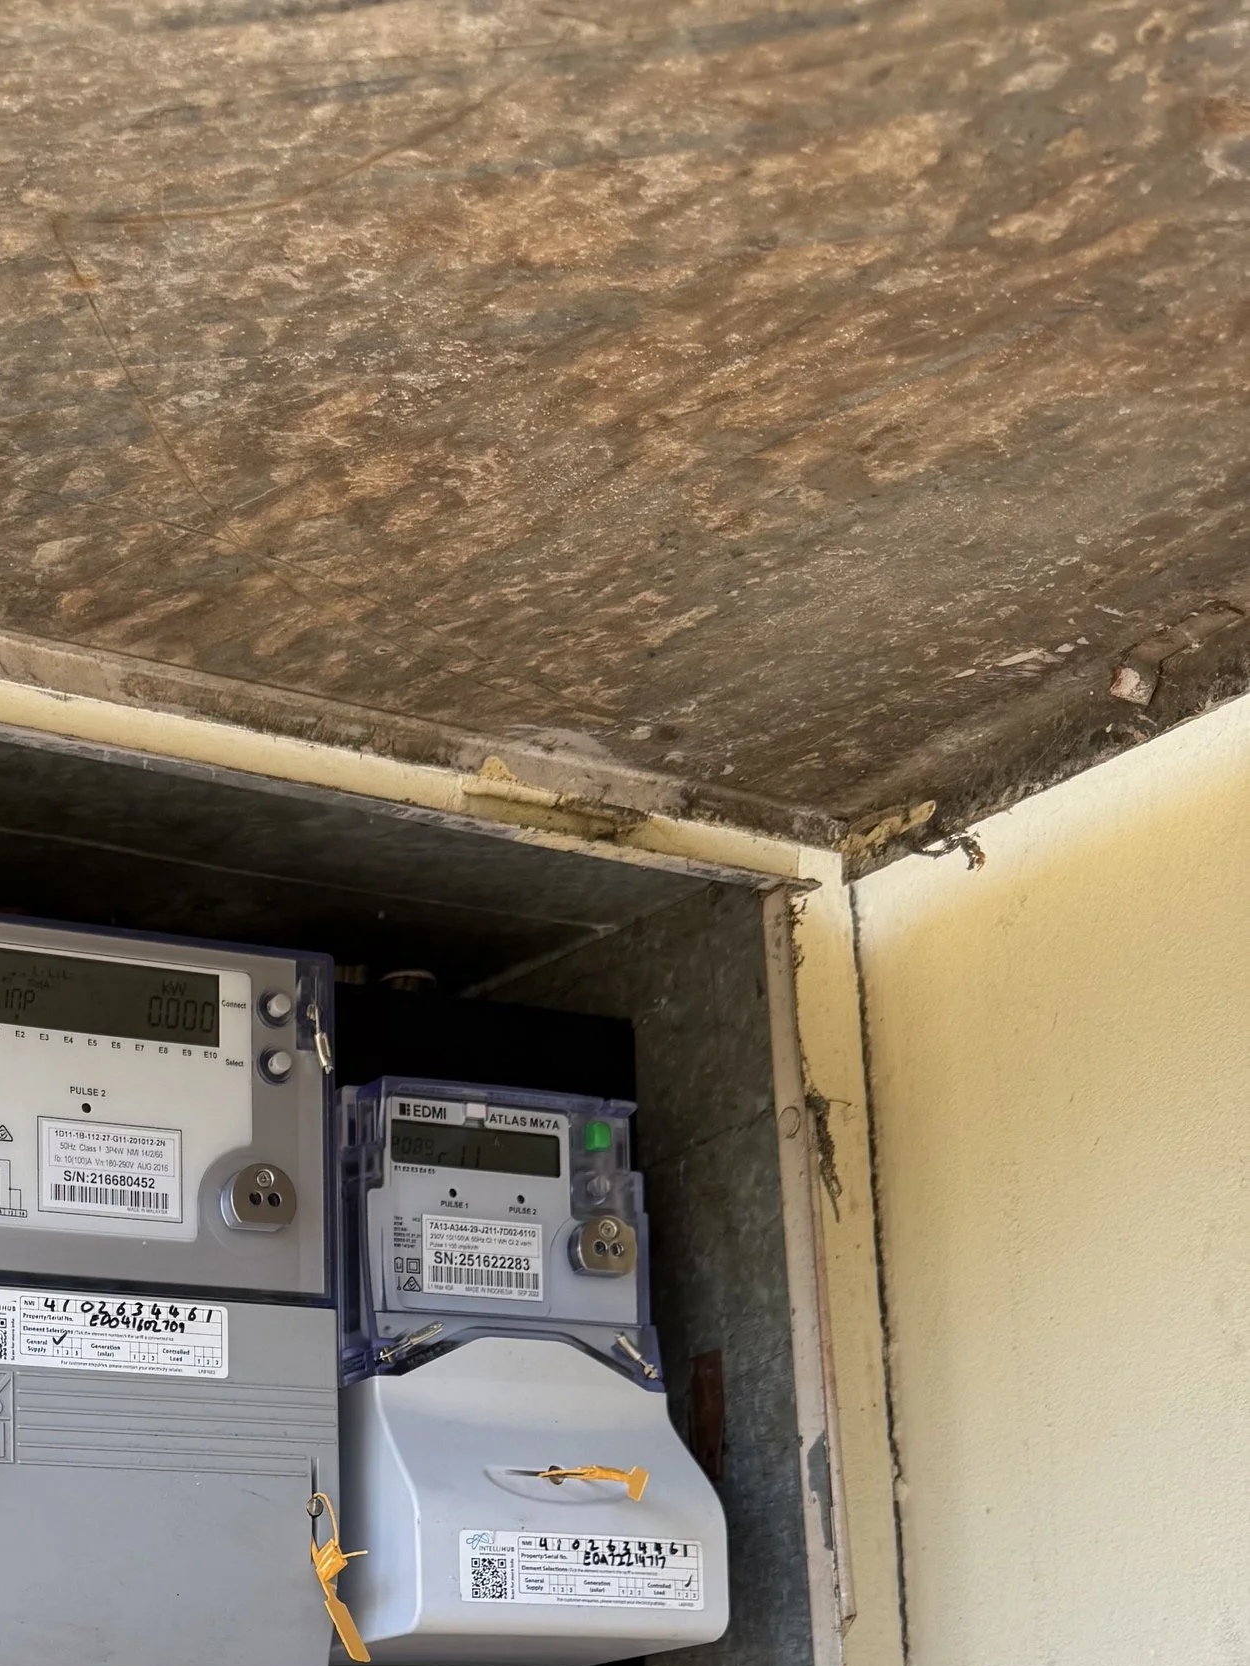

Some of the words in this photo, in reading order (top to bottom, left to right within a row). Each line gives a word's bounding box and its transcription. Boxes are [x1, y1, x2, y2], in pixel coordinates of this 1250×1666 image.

[221, 999, 247, 1010] Connect
[16, 1030, 26, 1038] E2
[40, 1034, 50, 1042] E3
[64, 1036, 74, 1044] E4
[88, 1038, 98, 1046] E5
[112, 1042, 121, 1050] E6
[134, 1044, 144, 1052] E7
[158, 1046, 168, 1055] E8
[182, 1049, 192, 1057] E9
[204, 1051, 218, 1060] E10
[225, 1058, 244, 1069] Select
[70, 1086, 98, 1097] PULSE
[100, 1090, 106, 1098] 2
[413, 1105, 447, 1120] EDMI
[490, 1113, 526, 1127] ATLAS
[530, 1118, 560, 1130] Mk7A
[64, 1170, 156, 1190] S/N:216680452
[440, 1200, 464, 1209] PULSE
[508, 1206, 531, 1215] PULSE
[434, 1251, 530, 1271] SN:251622283
[26, 1338, 48, 1346] General
[28, 1345, 46, 1354] Supply
[90, 1343, 121, 1351] Generation
[162, 1348, 190, 1356] Controlled
[522, 1564, 542, 1572] Element
[526, 1584, 544, 1592] Supply
